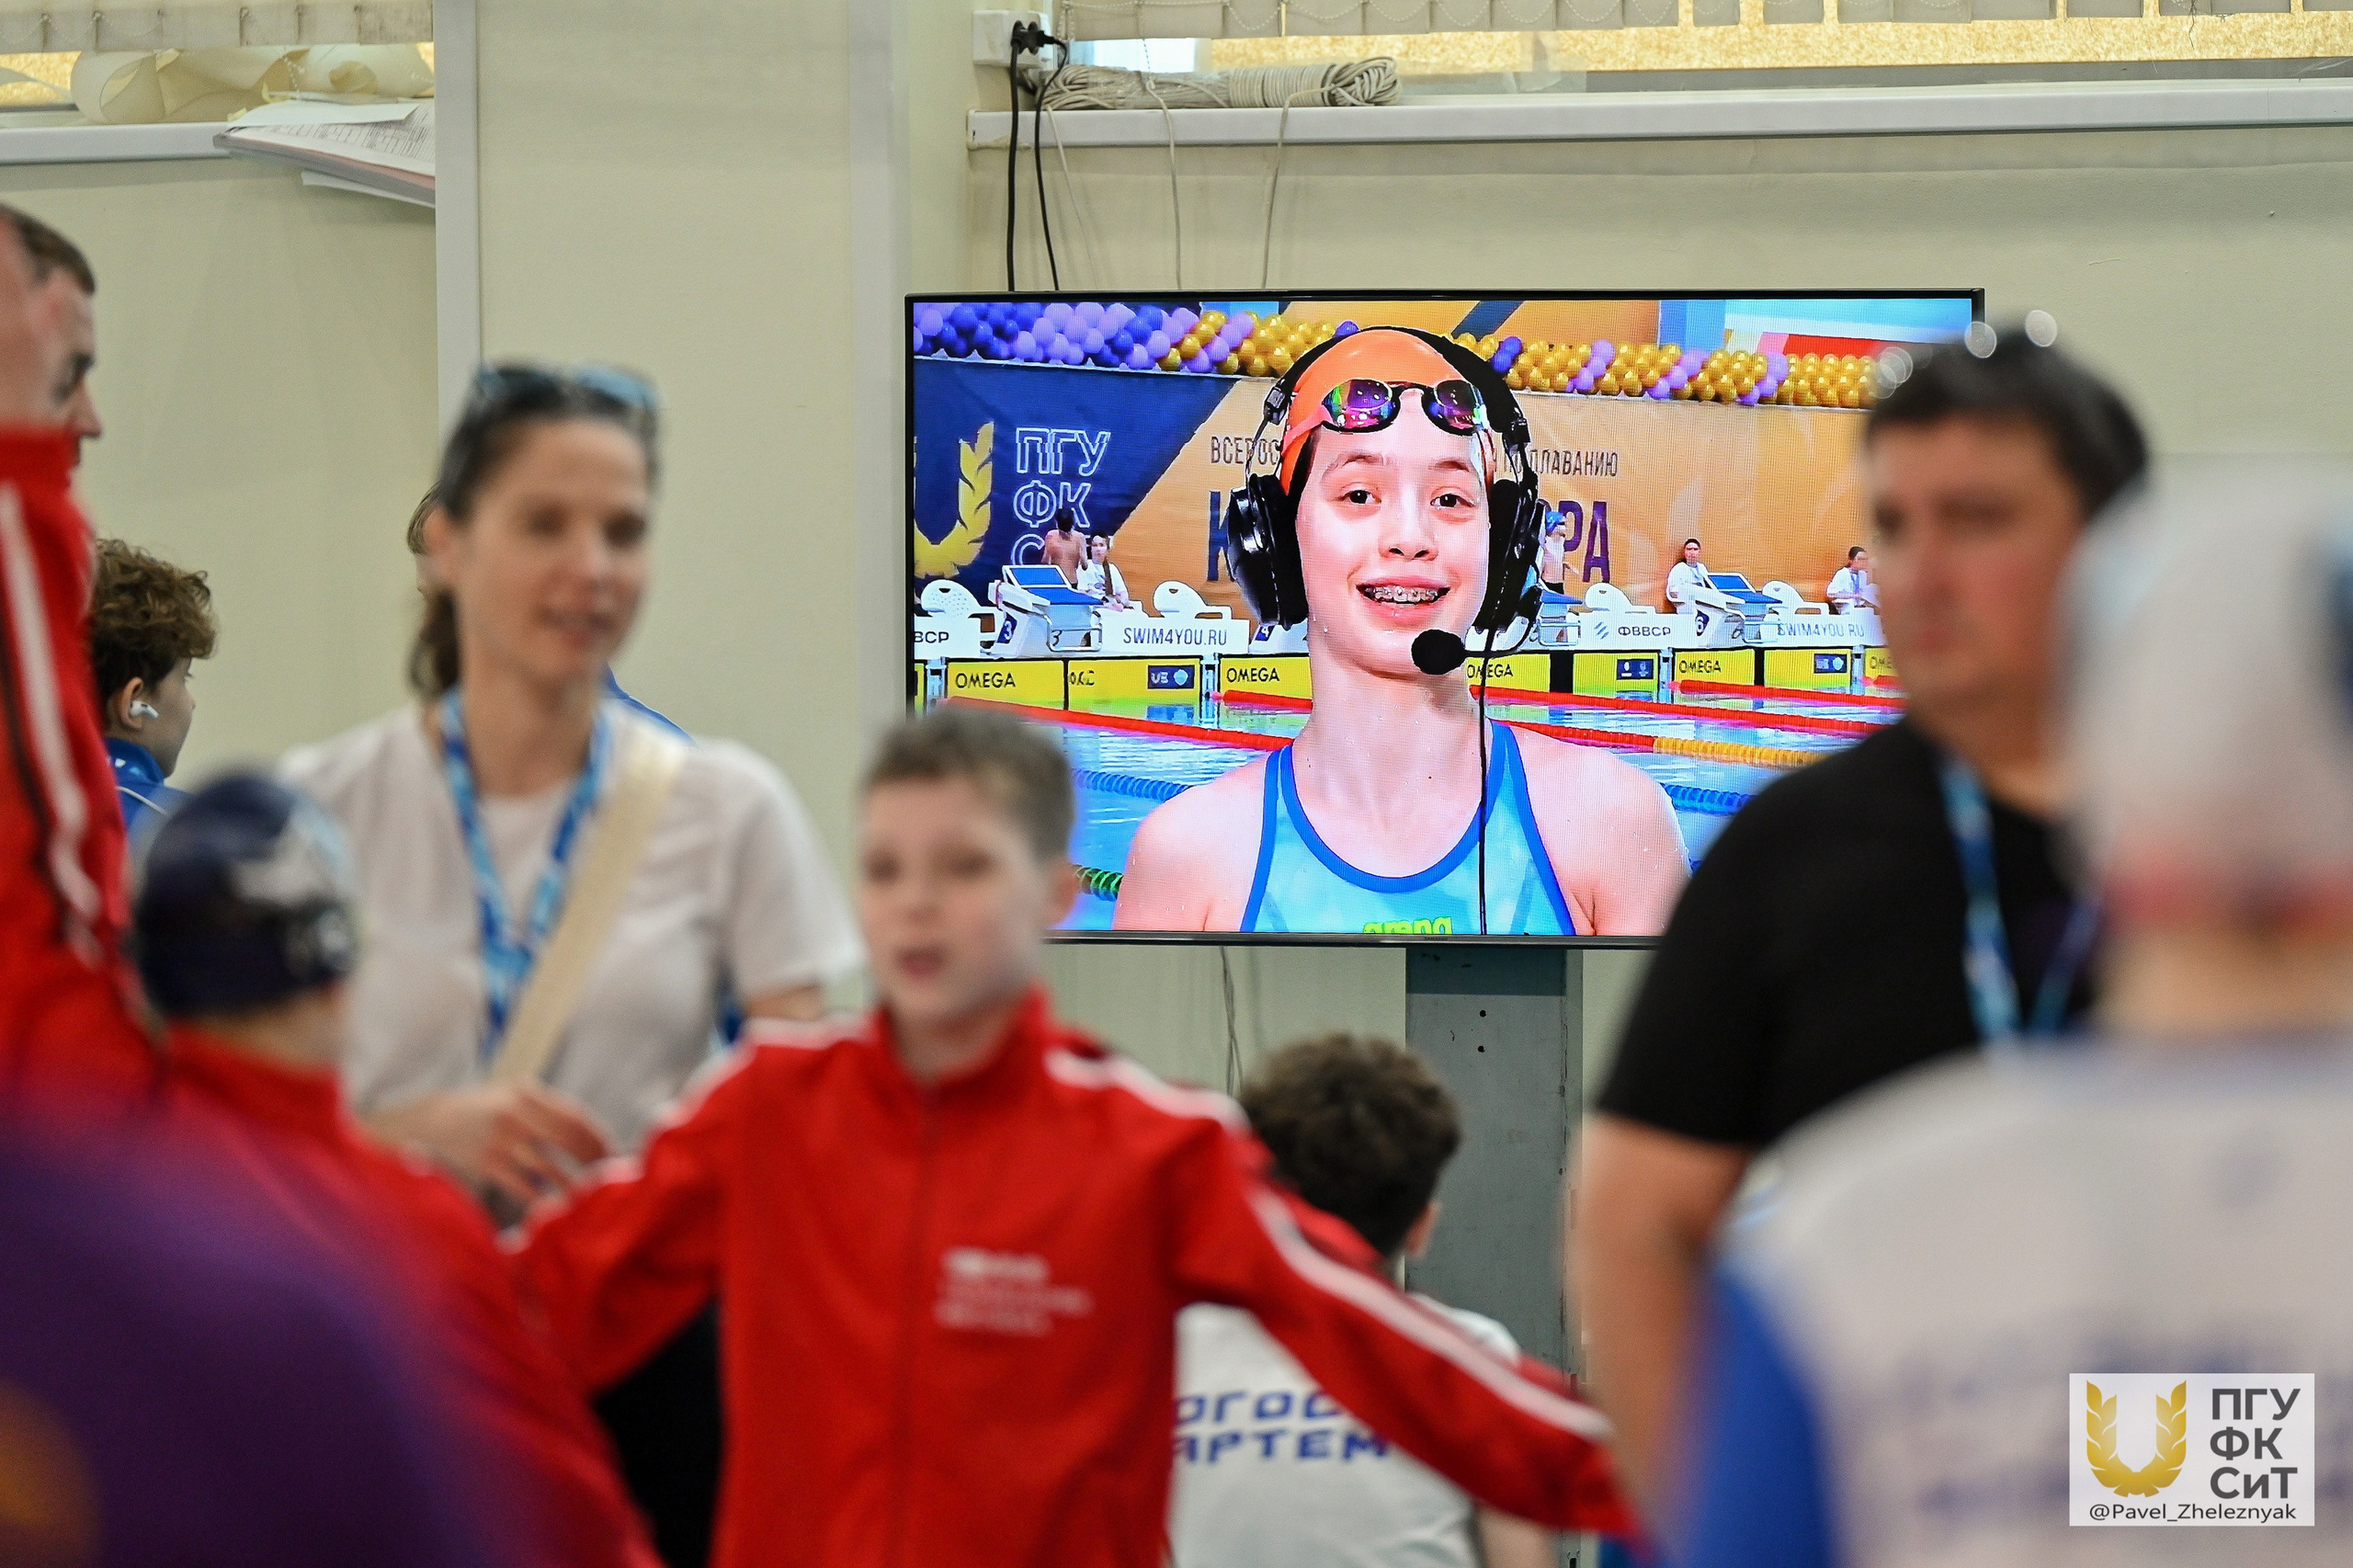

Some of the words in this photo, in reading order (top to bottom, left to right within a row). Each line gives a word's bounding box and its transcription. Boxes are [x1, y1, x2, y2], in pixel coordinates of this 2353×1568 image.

[1016, 427, 1110, 476] ПГУ
[1211, 436, 1280, 466] ВСЕРОС
[1013, 480, 1092, 528] ФК
[914, 631, 949, 644] ВСР
[1122, 627, 1228, 646] SWIM4YOU.RU
[1226, 666, 1280, 683] OMEGA
[1678, 659, 1722, 674] OMEGA
[955, 672, 1017, 688] OMEGA
[1176, 1391, 1342, 1424] ОГОС
